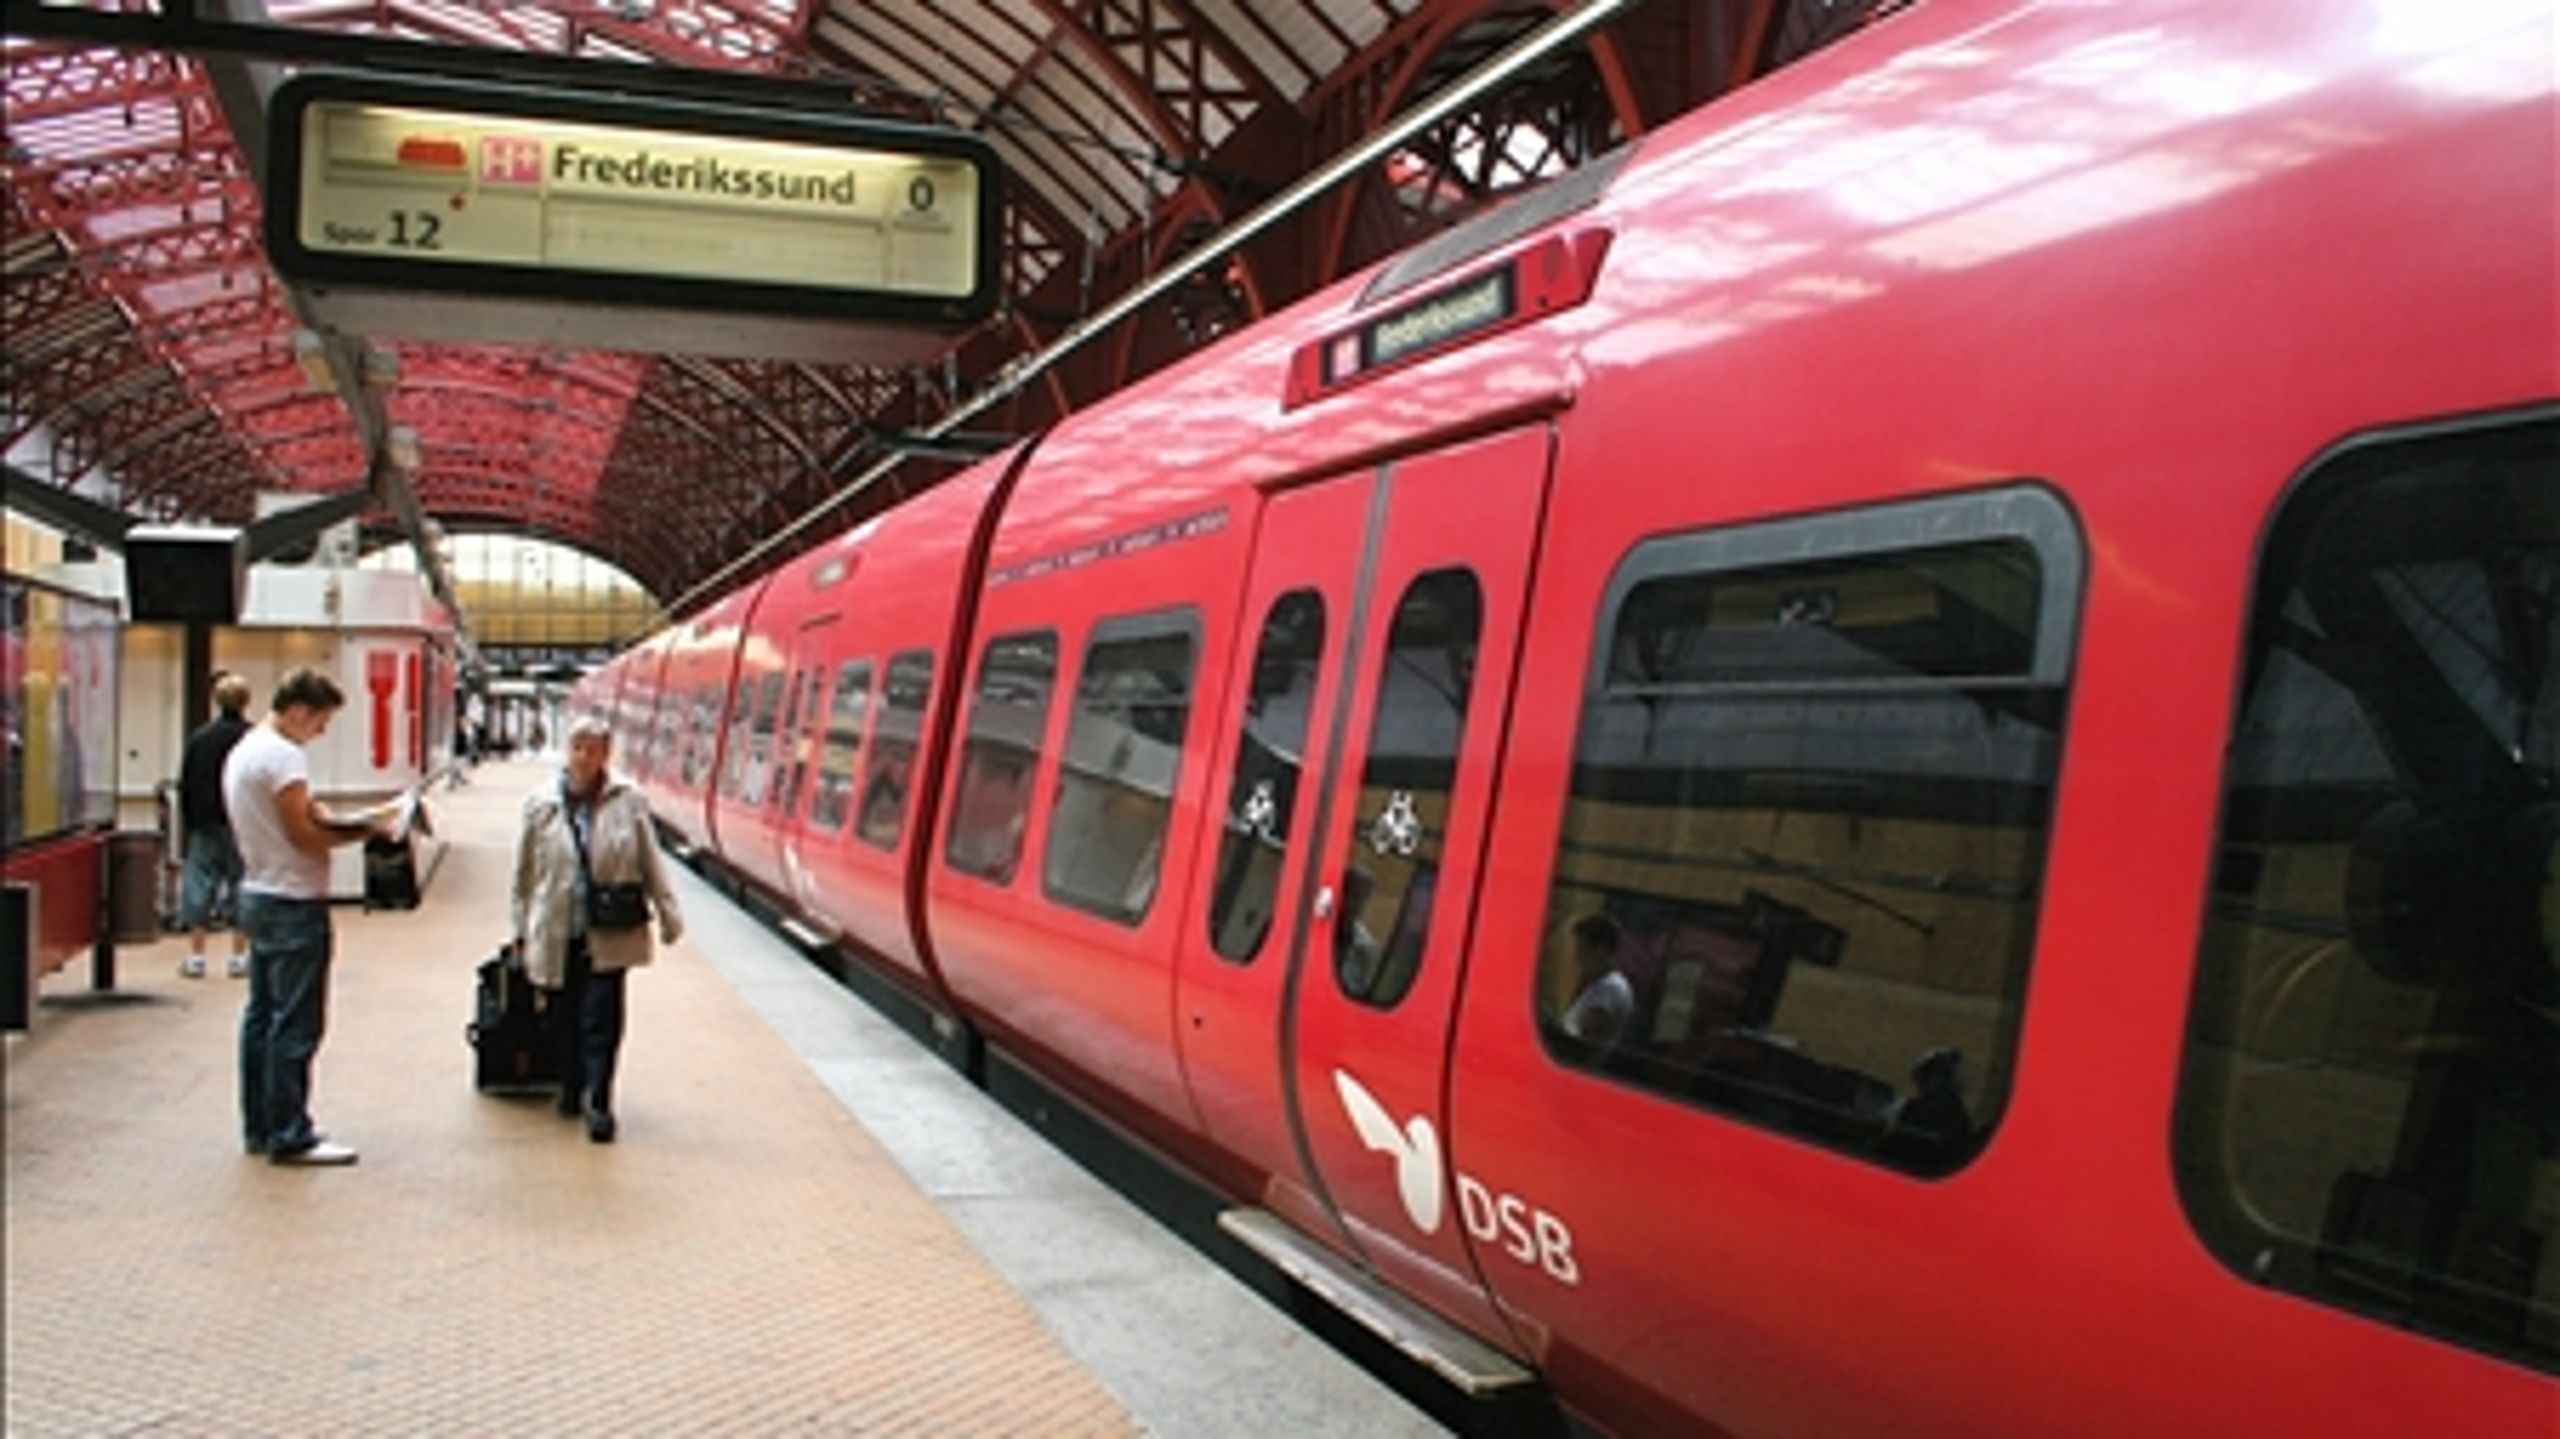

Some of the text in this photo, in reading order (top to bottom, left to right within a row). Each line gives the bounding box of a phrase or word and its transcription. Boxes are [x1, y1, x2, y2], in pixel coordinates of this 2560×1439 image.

[553, 145, 855, 204] Frederikssund
[909, 174, 934, 212] 0
[387, 209, 442, 250] 12
[1456, 1170, 1578, 1285] DSB
